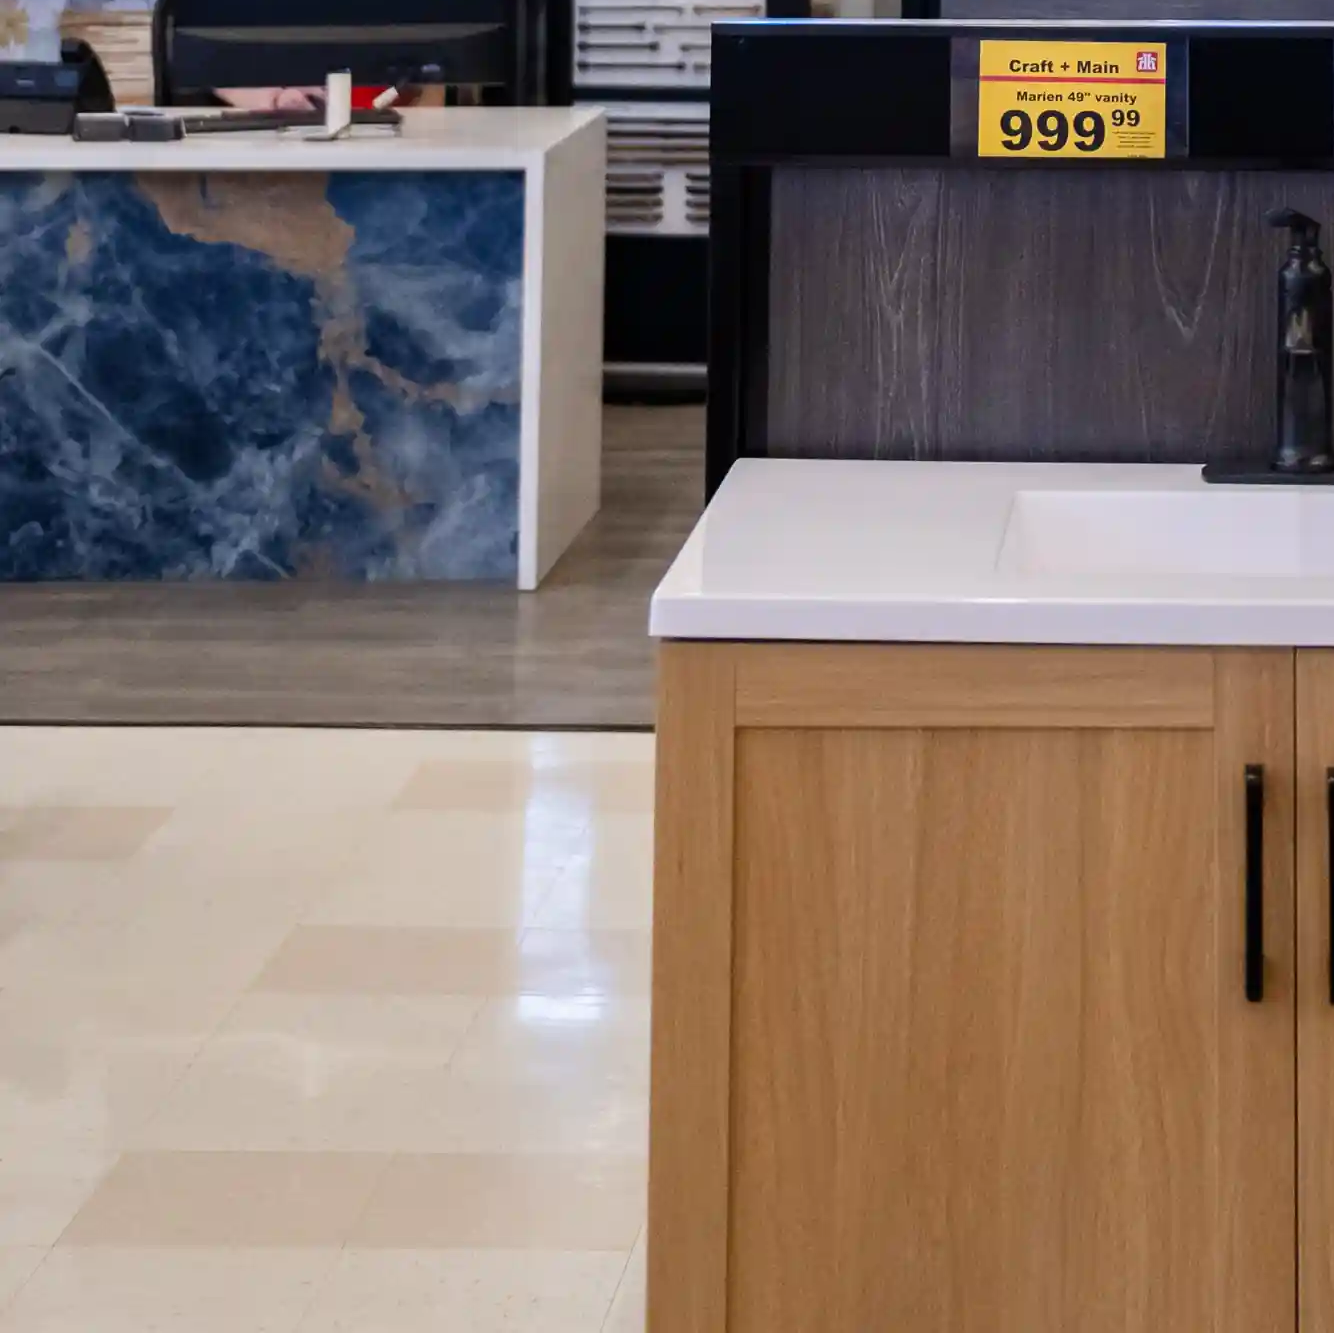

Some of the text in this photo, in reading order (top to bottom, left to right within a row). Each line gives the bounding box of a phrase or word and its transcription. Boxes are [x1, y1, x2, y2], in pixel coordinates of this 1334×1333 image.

[1009, 59, 1053, 73] Craft
[1077, 60, 1120, 74] Main
[1016, 91, 1063, 102] Marien
[1095, 92, 1137, 105] vanity
[1000, 109, 1106, 152] 999
[1111, 109, 1141, 126] 99
